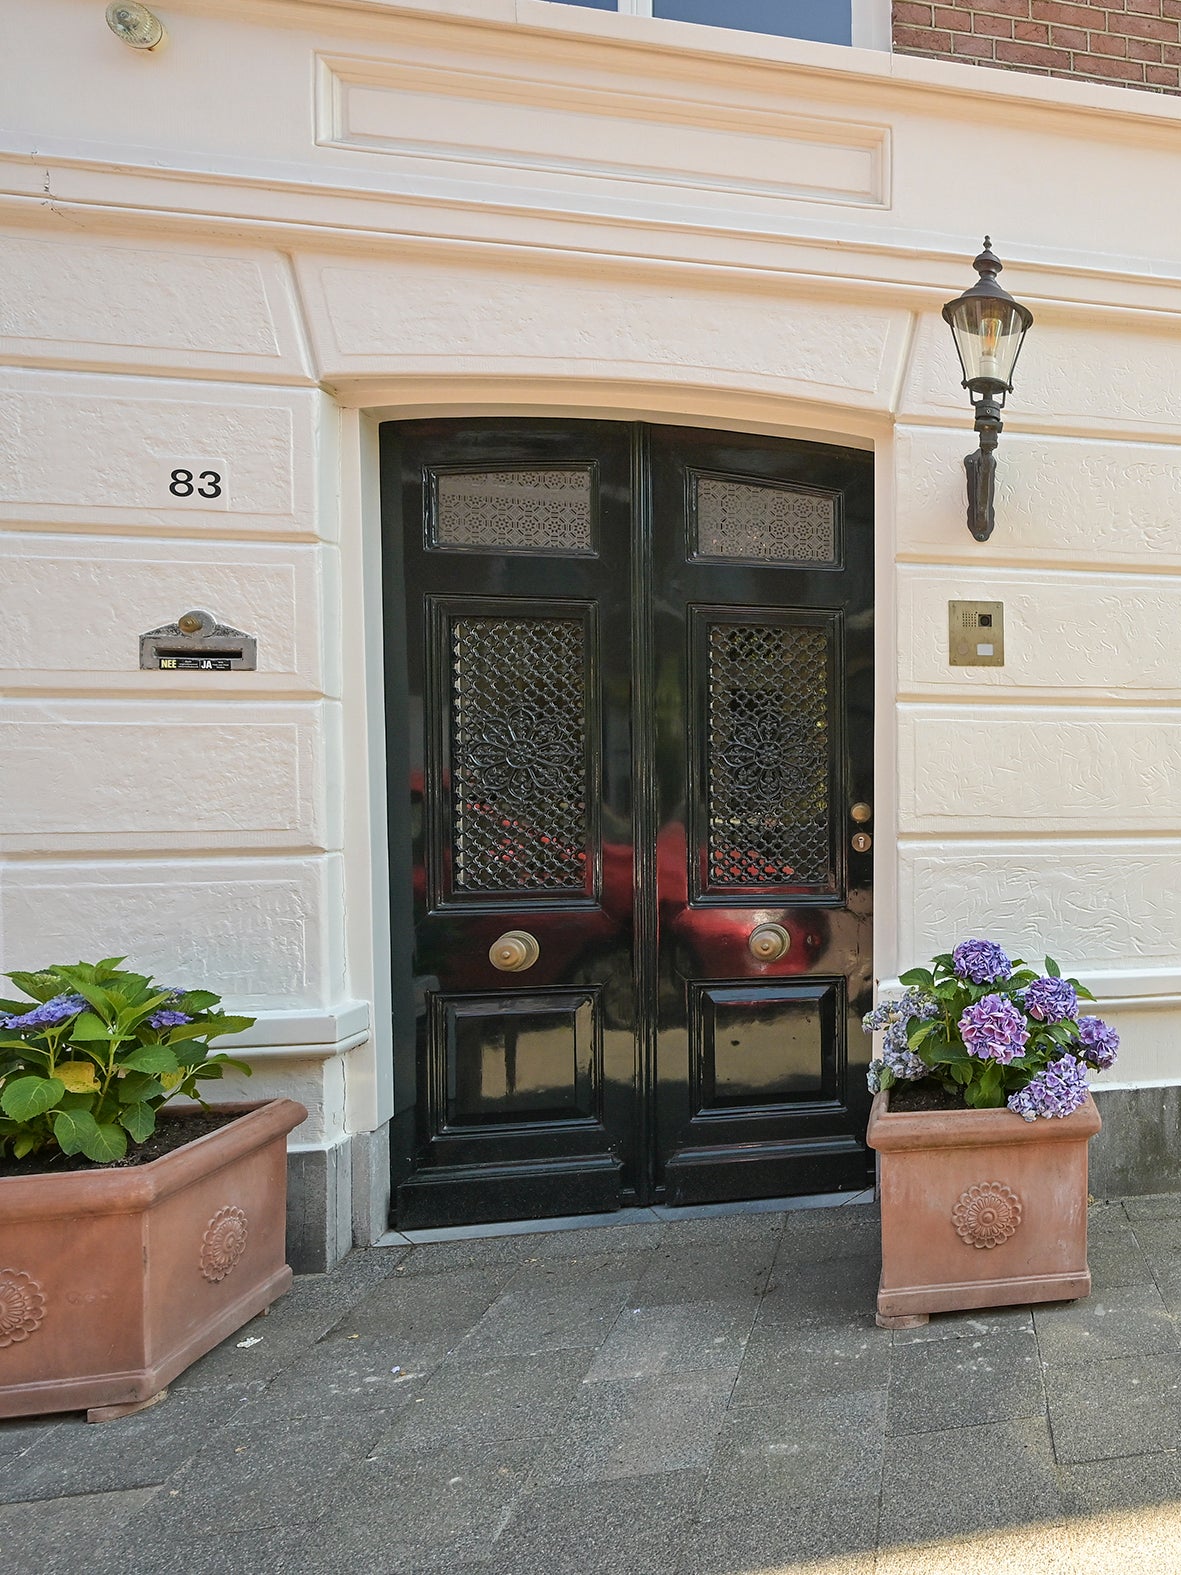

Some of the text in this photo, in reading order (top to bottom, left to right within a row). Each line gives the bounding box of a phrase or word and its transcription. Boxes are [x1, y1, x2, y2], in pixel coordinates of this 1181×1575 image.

[169, 468, 222, 499] 83
[161, 659, 177, 669] NEE
[201, 660, 213, 669] JA
